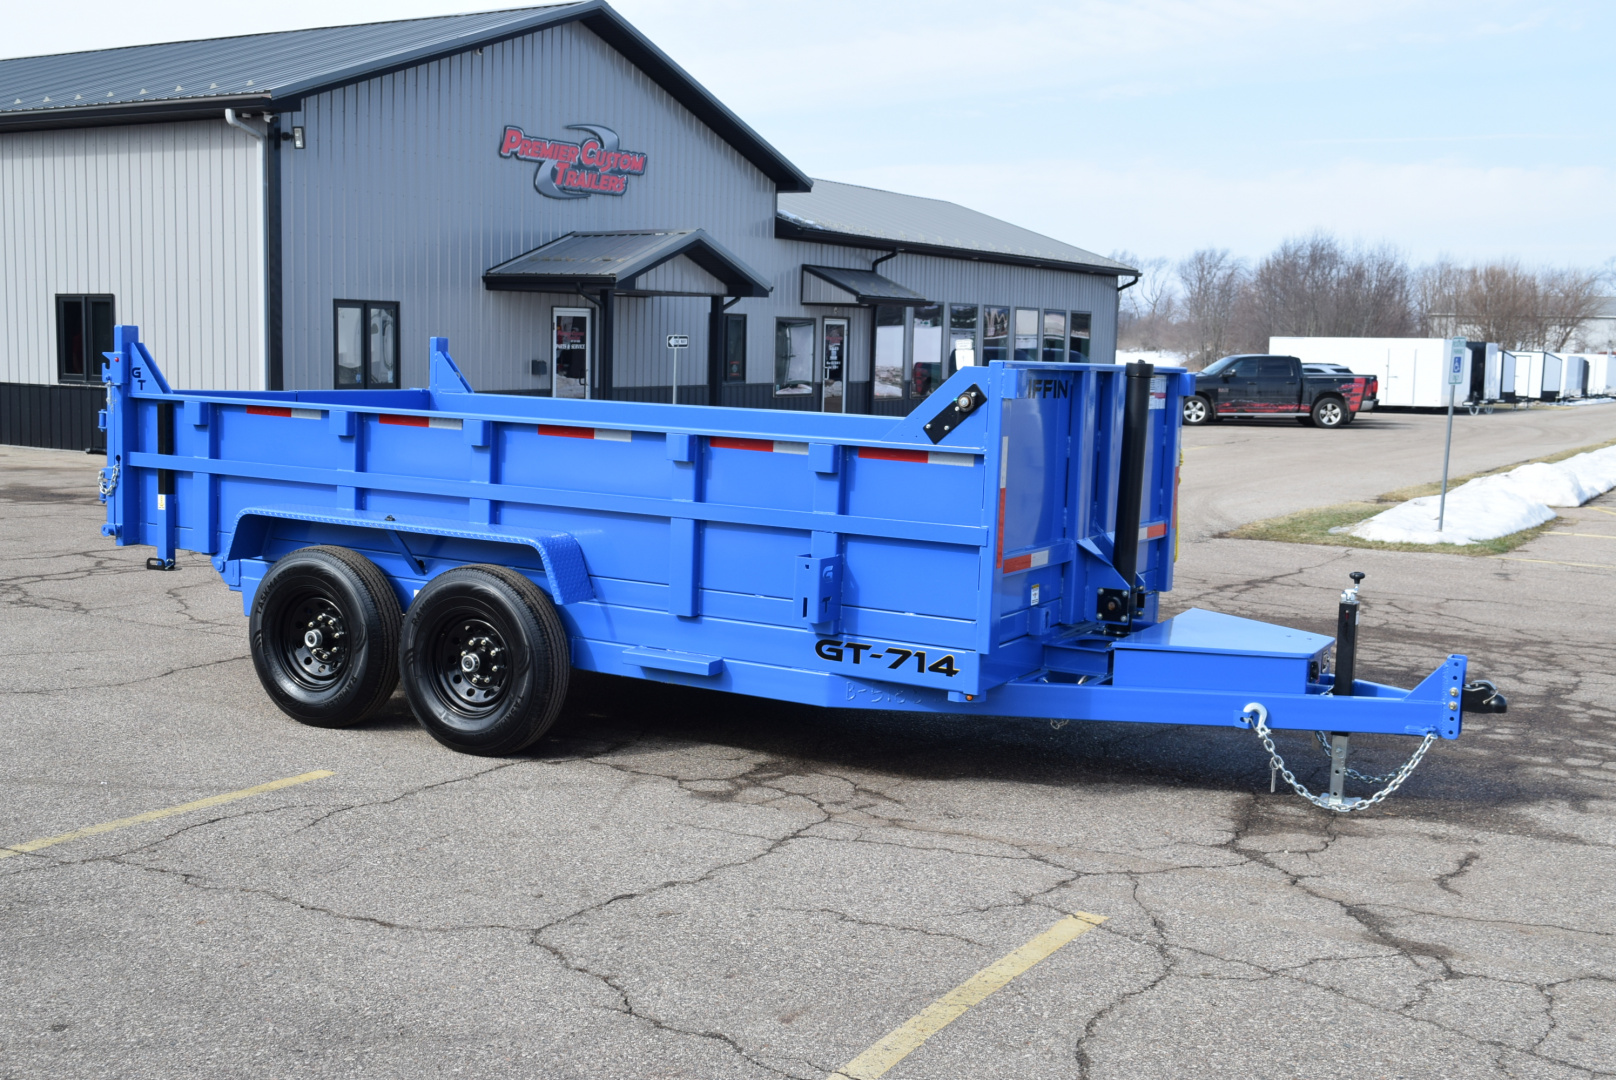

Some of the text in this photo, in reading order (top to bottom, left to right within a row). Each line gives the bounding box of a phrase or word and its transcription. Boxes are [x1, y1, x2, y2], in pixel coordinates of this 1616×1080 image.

[500, 127, 646, 172] PREMIER CUSTOM
[555, 161, 627, 193] TRAILERS
[1027, 378, 1069, 399] IFFIN
[815, 639, 961, 678] GT-714
